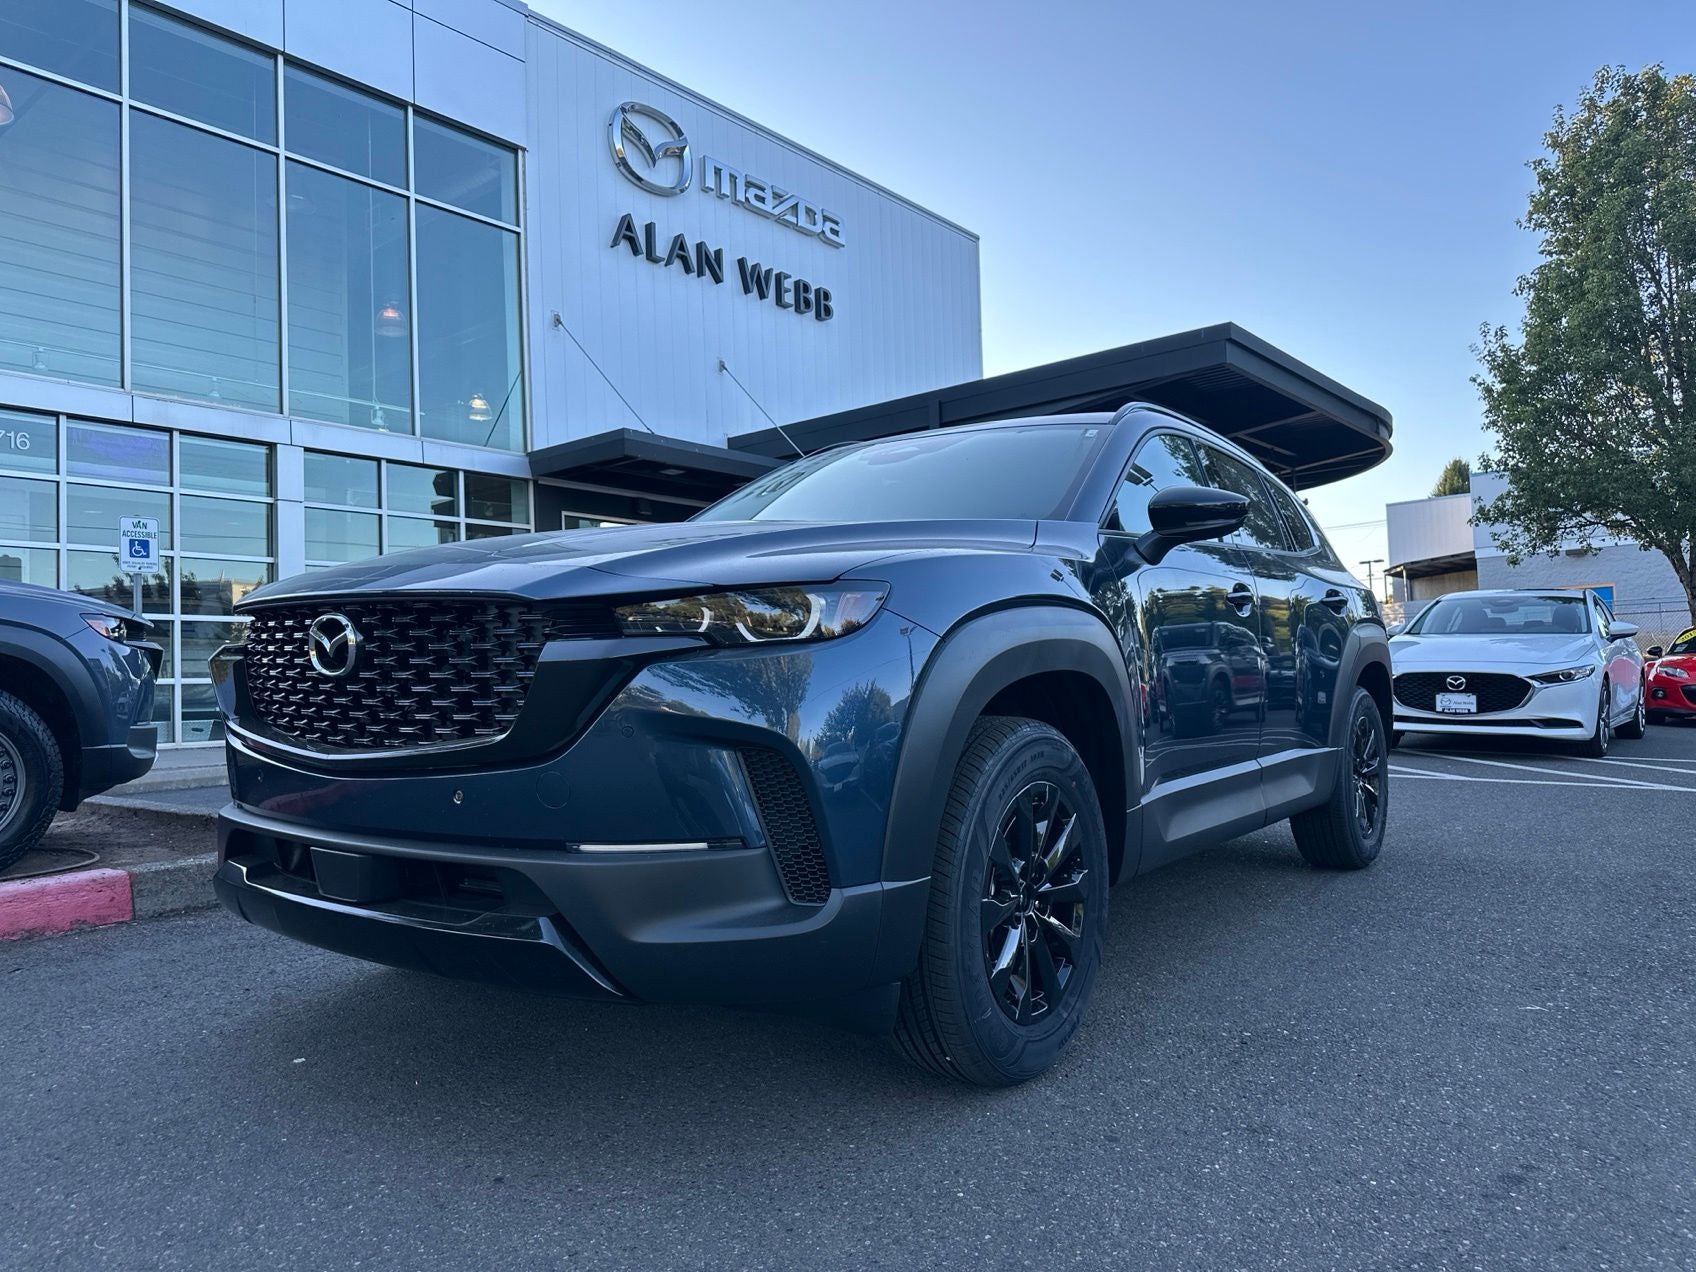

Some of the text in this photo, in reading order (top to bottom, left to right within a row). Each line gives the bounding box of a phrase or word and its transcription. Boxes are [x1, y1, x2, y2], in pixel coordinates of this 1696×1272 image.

[701, 155, 846, 249] mazda
[610, 212, 835, 322] ALAN WEBB
[122, 530, 157, 539] ACCESSIBLE
[131, 520, 148, 529] VAN
